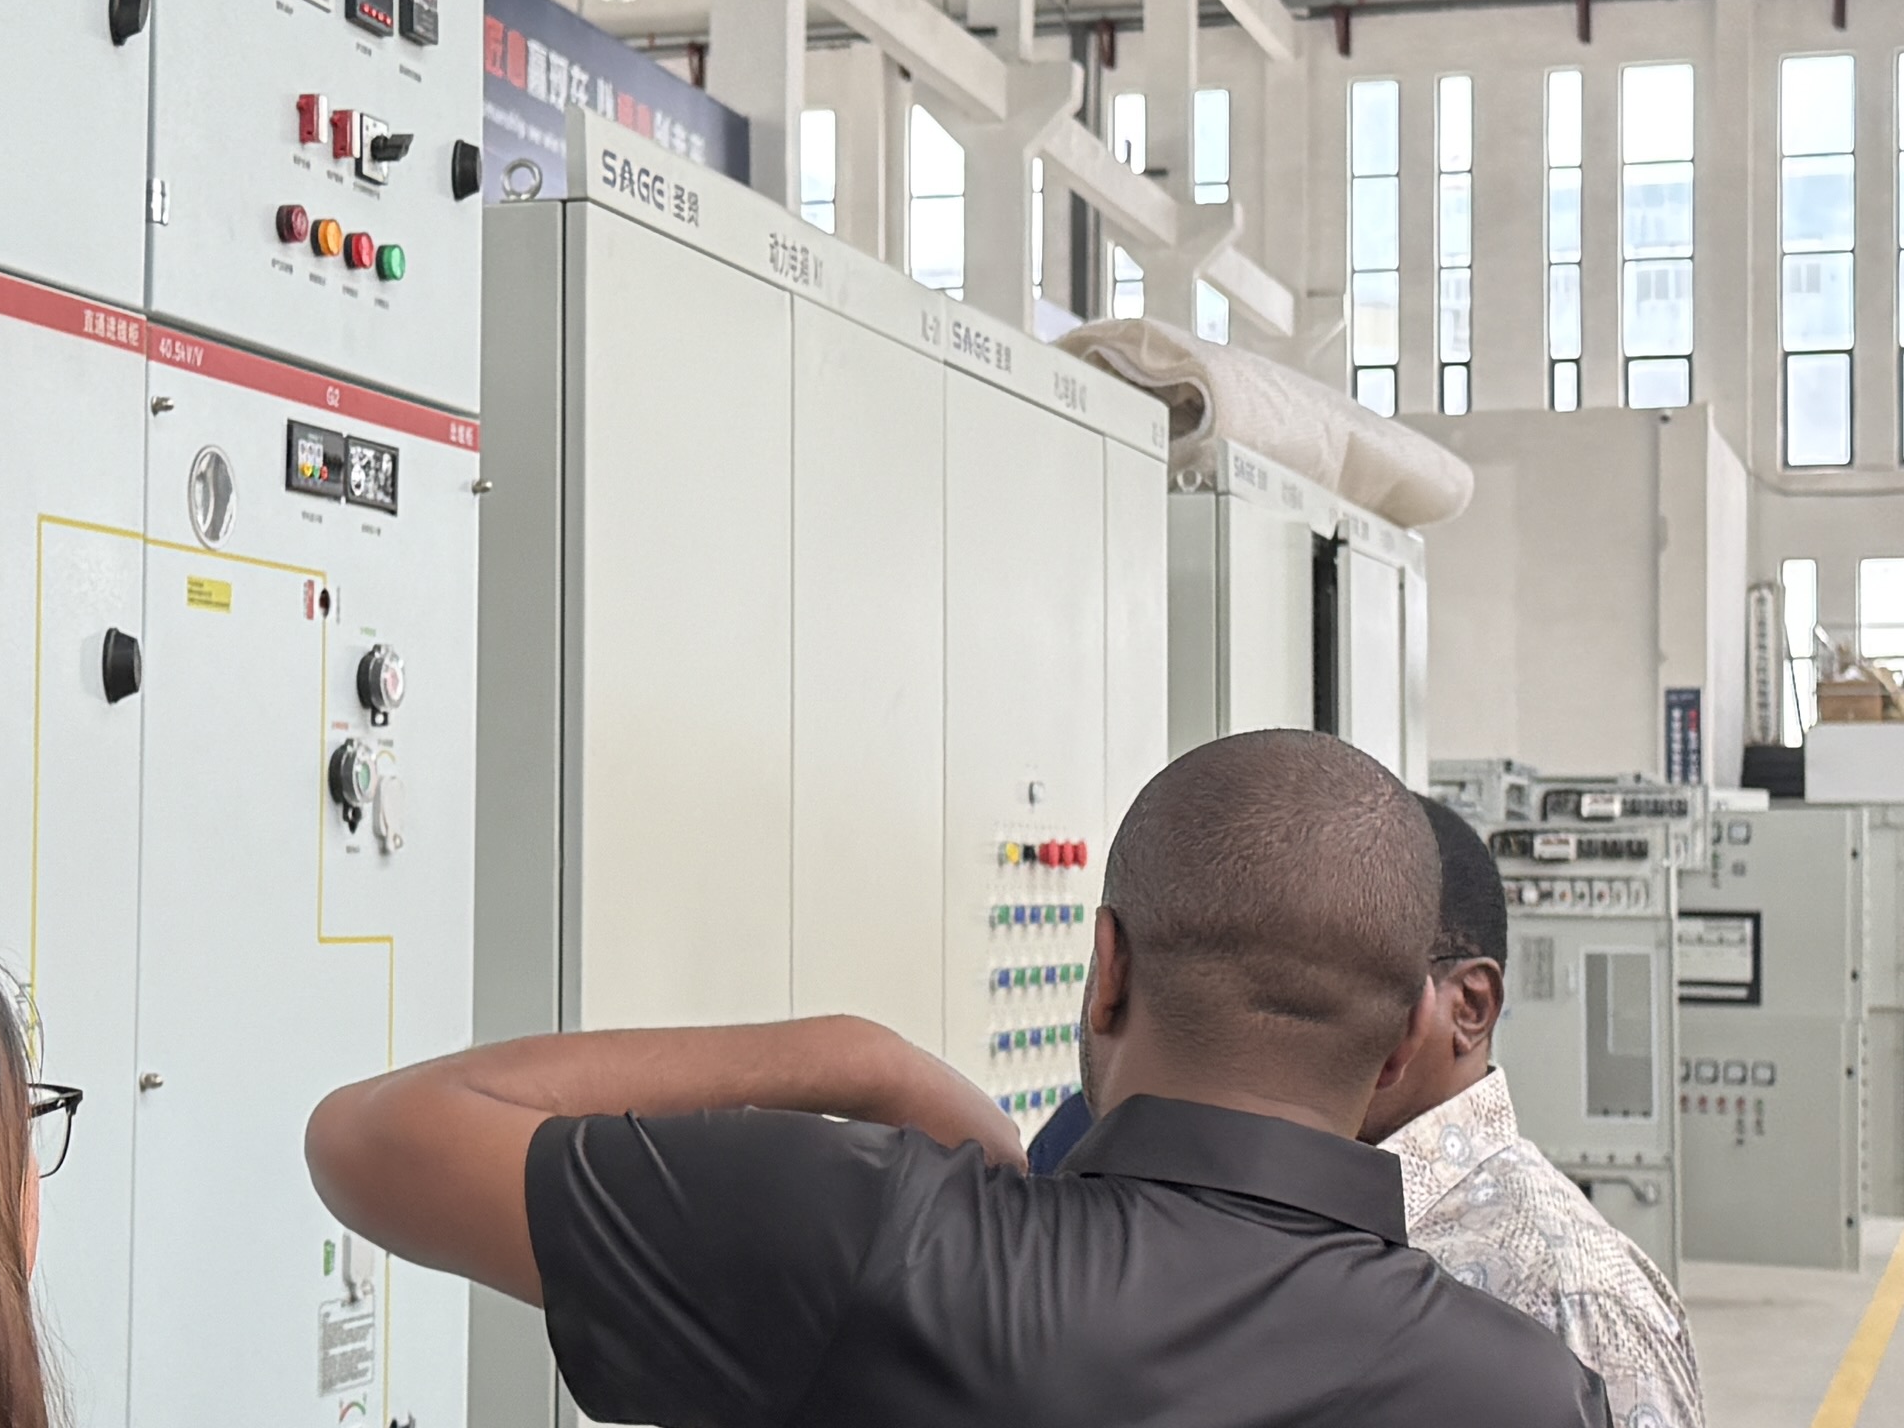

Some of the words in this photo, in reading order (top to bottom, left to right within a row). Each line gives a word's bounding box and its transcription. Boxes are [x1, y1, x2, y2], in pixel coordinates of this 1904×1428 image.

[601, 149, 665, 212] SAGE
[952, 321, 991, 364] SAGE
[326, 385, 340, 408] G2
